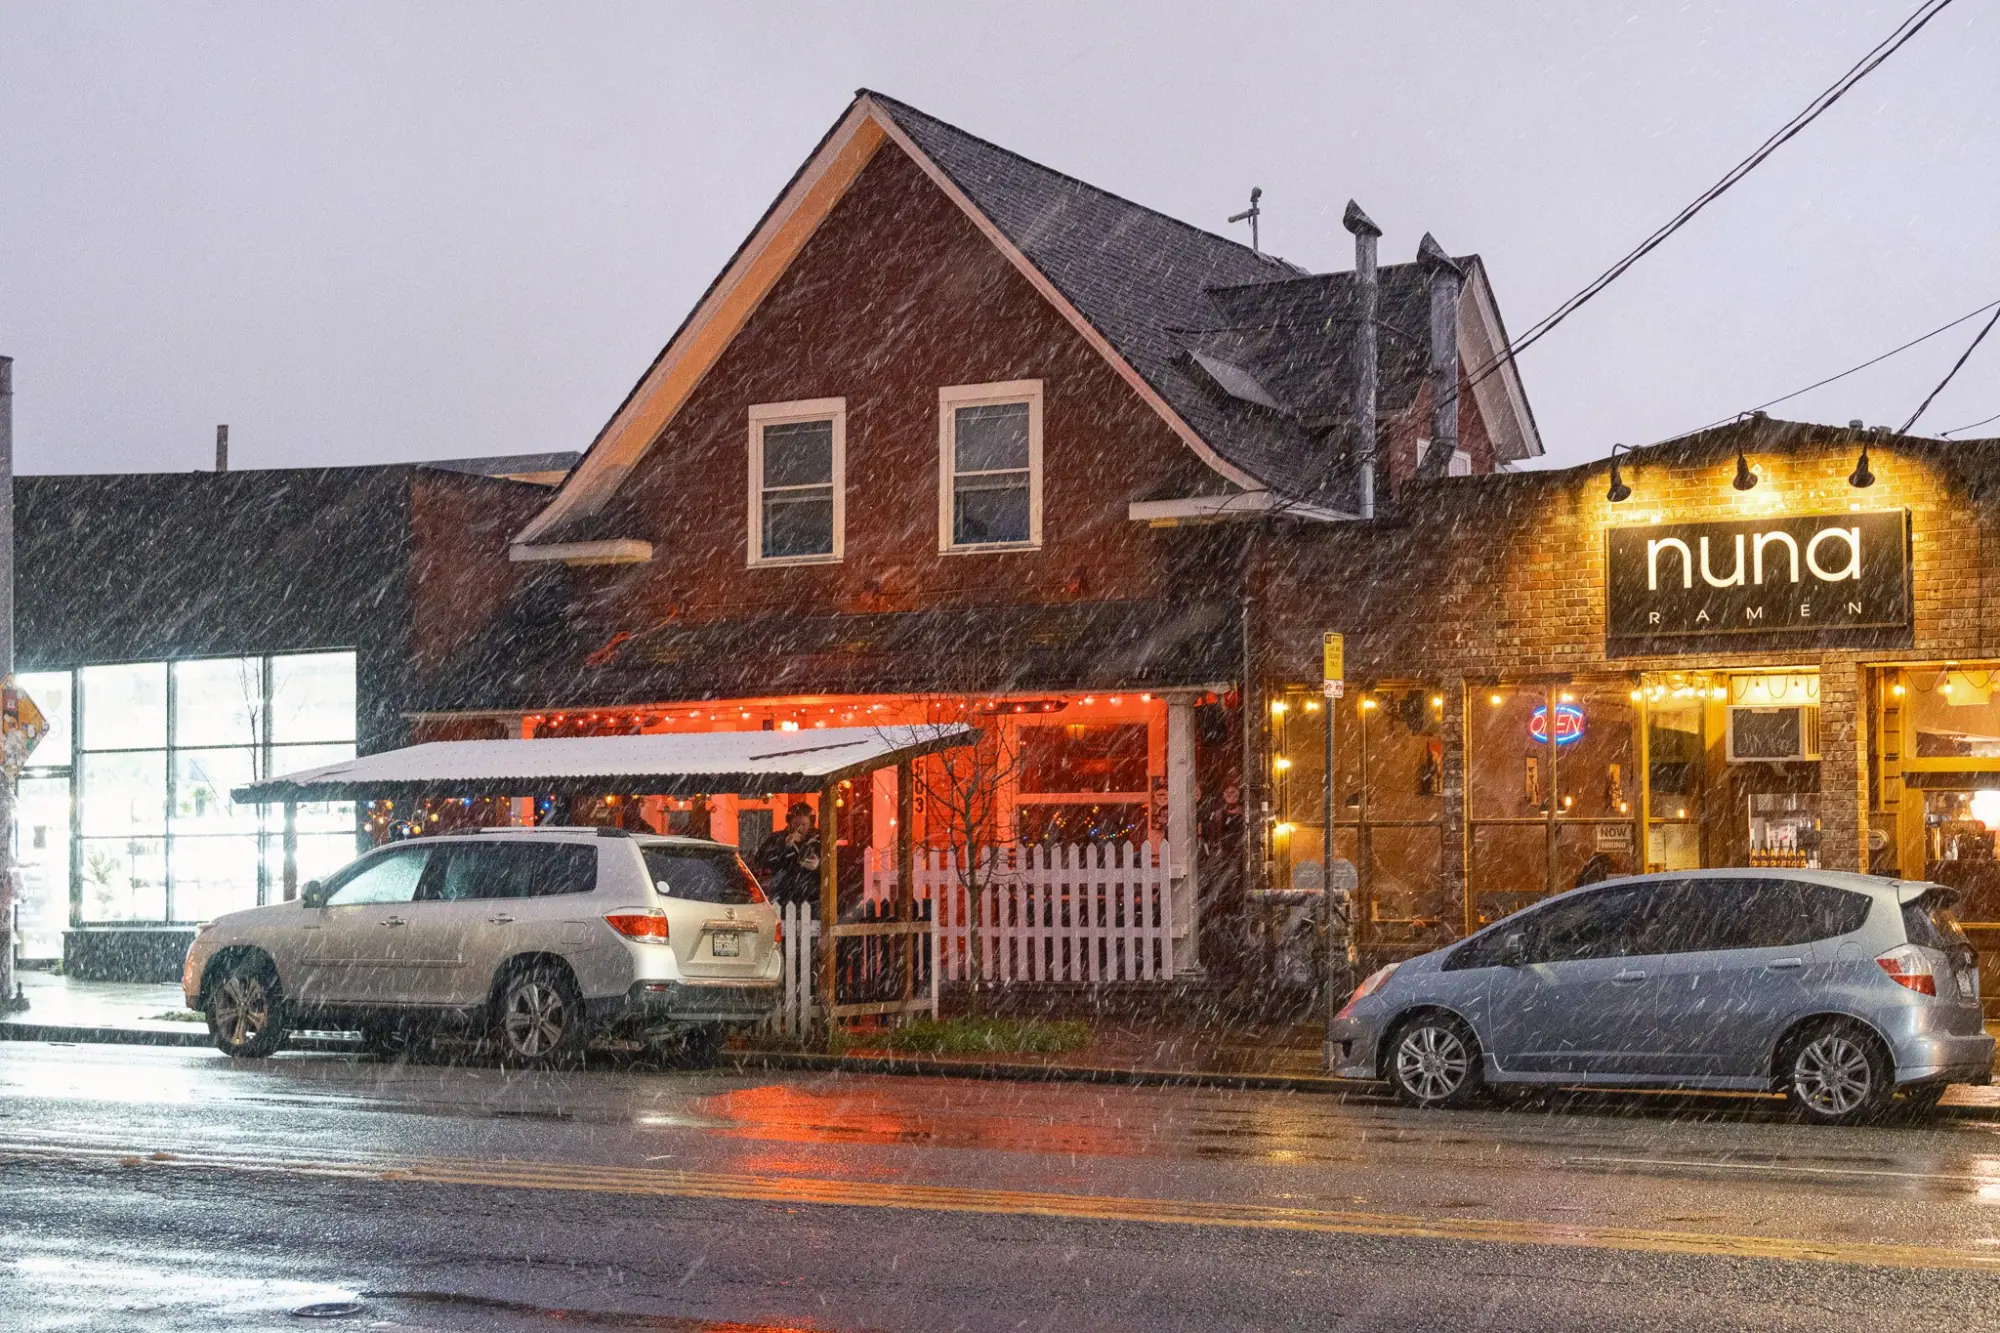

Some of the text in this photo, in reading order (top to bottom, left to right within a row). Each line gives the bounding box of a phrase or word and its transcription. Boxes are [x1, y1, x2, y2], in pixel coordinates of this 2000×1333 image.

[1648, 527, 1861, 591] nuna
[1649, 602, 1862, 624] RAMEN
[1531, 714, 1583, 734] OEN
[1601, 828, 1628, 837] NOW
